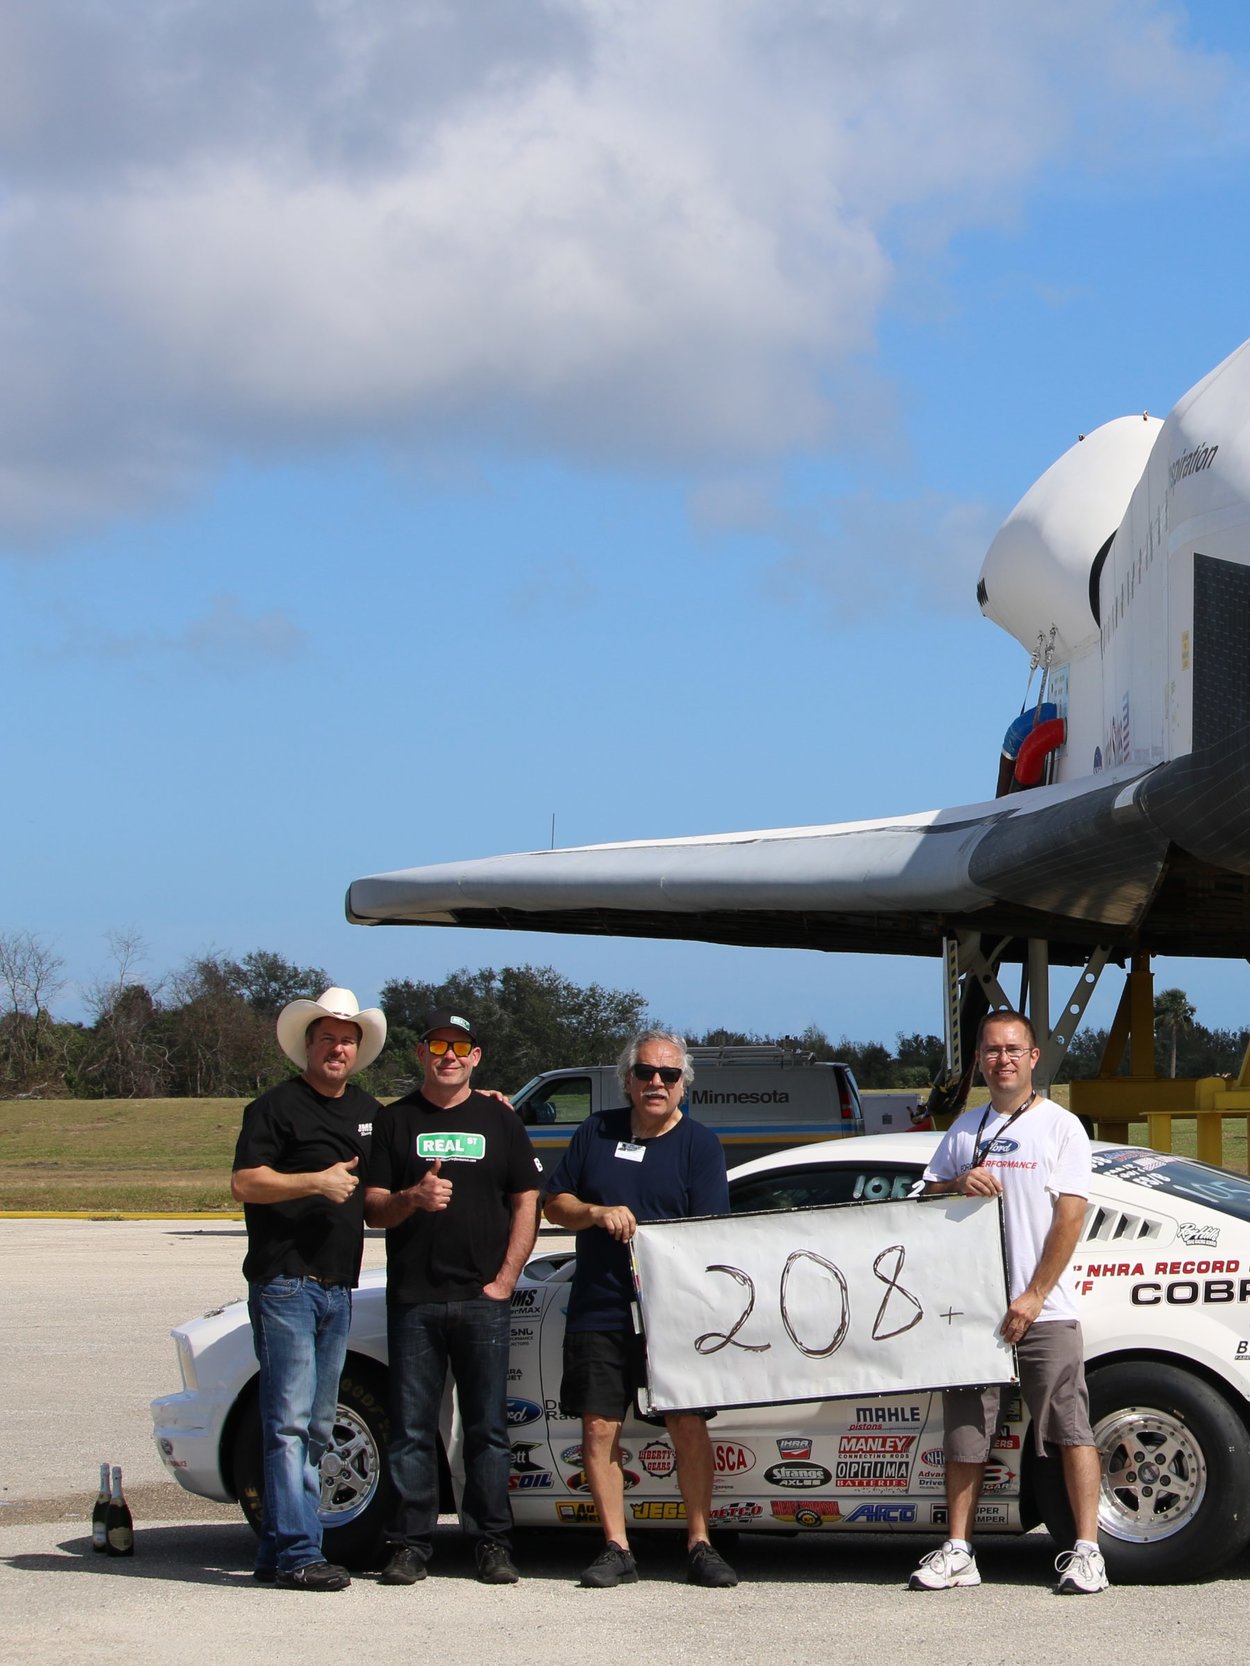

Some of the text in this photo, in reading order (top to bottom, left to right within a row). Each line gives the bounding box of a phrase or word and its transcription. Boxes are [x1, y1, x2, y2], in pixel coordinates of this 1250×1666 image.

[692, 1089, 789, 1105] Minnesota
[423, 1139, 465, 1152] REAL
[980, 1160, 1038, 1169] ERFORMANCE
[1087, 1263, 1144, 1277] NHRA
[1155, 1260, 1240, 1275] RECORD
[511, 1289, 538, 1307] MS
[510, 1307, 540, 1315] erMAX
[856, 1407, 920, 1422] MAHLE
[849, 1423, 882, 1431] pistons
[841, 1438, 907, 1451] MANLEY
[713, 1445, 748, 1472] SCA
[927, 1452, 945, 1464] NH
[647, 1462, 671, 1471] GEARS
[837, 1463, 908, 1478] OPTIMA
[773, 1467, 824, 1480] Strange
[509, 1473, 552, 1488] SOIL
[577, 1503, 595, 1513] Au
[844, 1504, 916, 1522] AFCO
